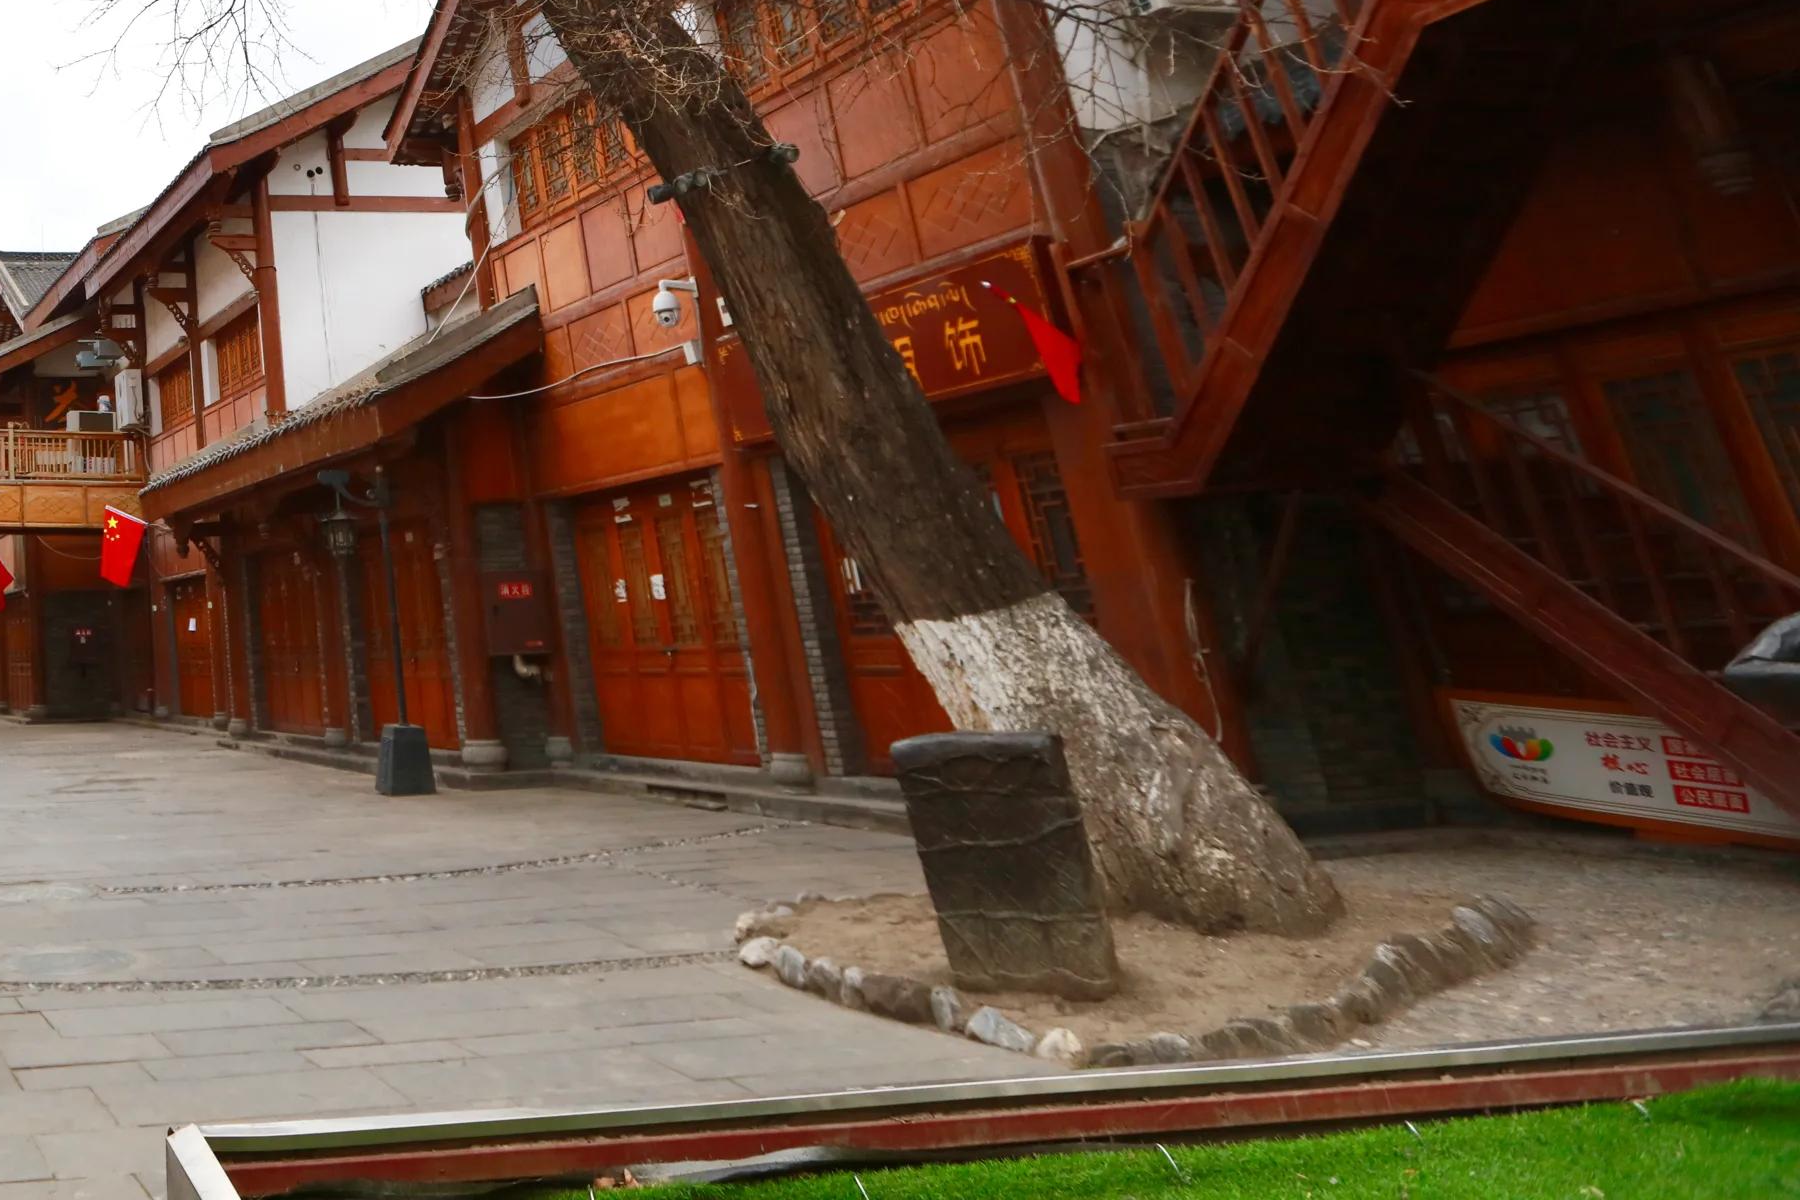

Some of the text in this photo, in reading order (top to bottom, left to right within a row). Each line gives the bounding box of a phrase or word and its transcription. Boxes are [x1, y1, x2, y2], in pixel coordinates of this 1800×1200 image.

[1584, 731, 1656, 752] 社会主义
[1601, 753, 1649, 776] 核心
[1608, 780, 1655, 799] 价值观
